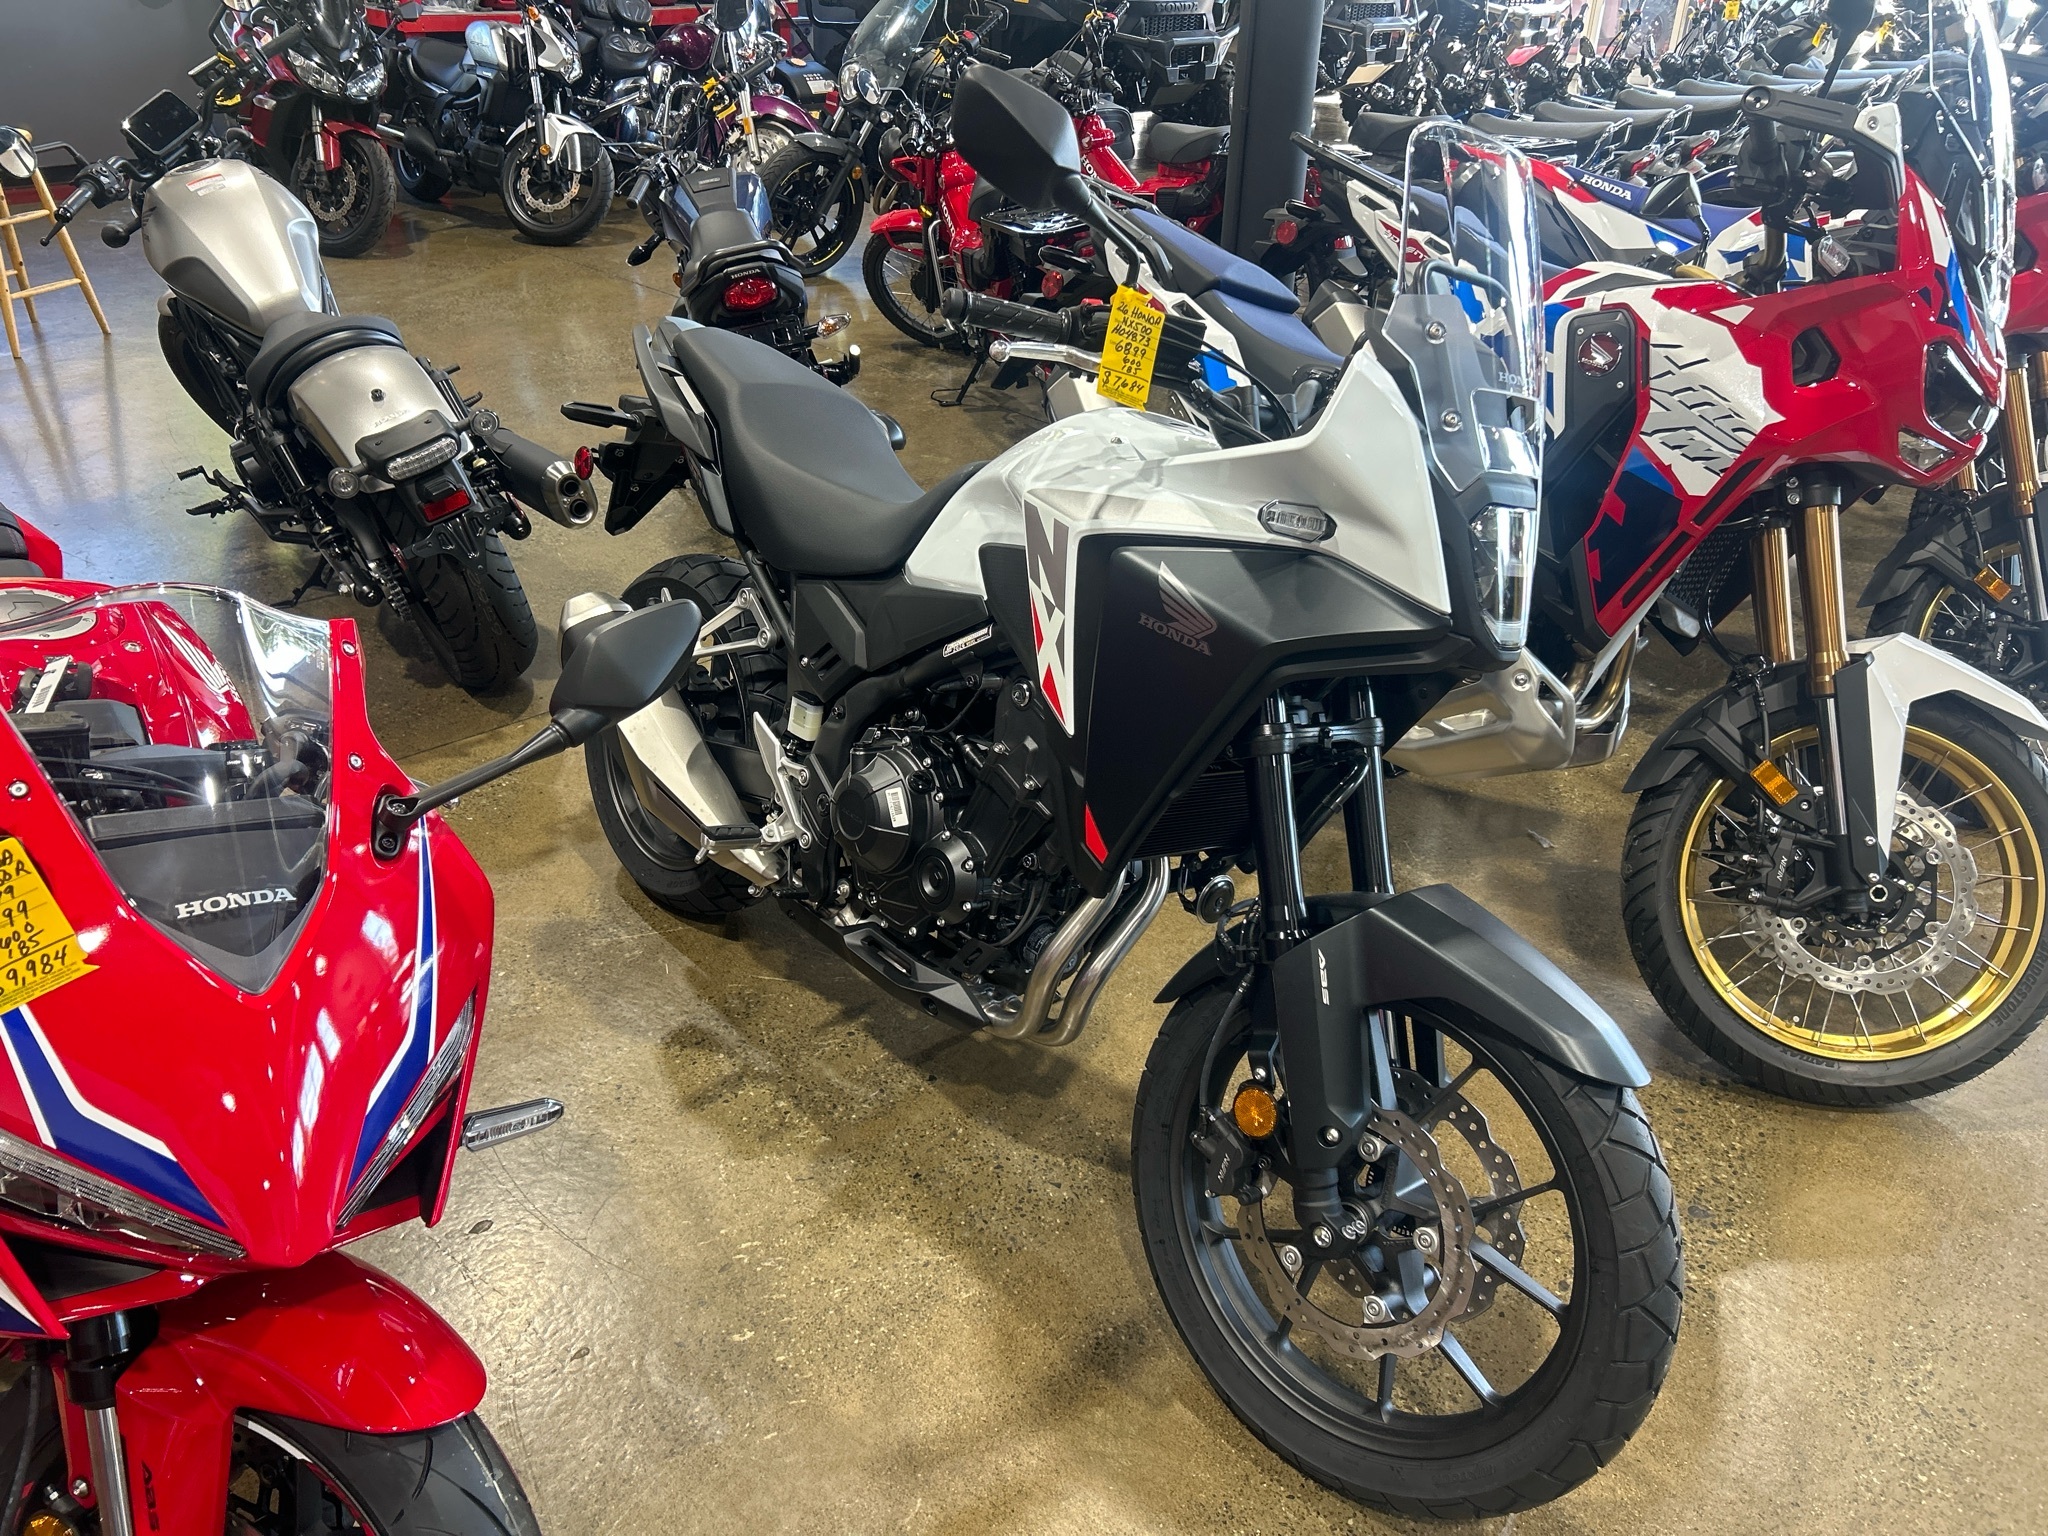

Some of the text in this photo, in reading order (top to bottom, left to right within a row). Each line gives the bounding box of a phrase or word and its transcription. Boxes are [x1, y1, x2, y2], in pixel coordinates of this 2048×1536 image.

[1156, 2, 1198, 12] HONDA
[1580, 174, 1632, 201] HONDA
[731, 268, 761, 279] HONDA
[1117, 302, 1162, 326] 26 HONDA
[1122, 316, 1152, 335] NX500
[1115, 340, 1147, 360] 6899
[1121, 365, 1142, 376] 185
[1123, 355, 1141, 368] 600
[1581, 357, 1609, 371] HONDA
[1138, 612, 1213, 656] HONDA
[175, 888, 297, 919] HONDA
[8, 929, 44, 957] 185
[1318, 948, 1330, 1006] ABS
[142, 1460, 160, 1532] ABS
